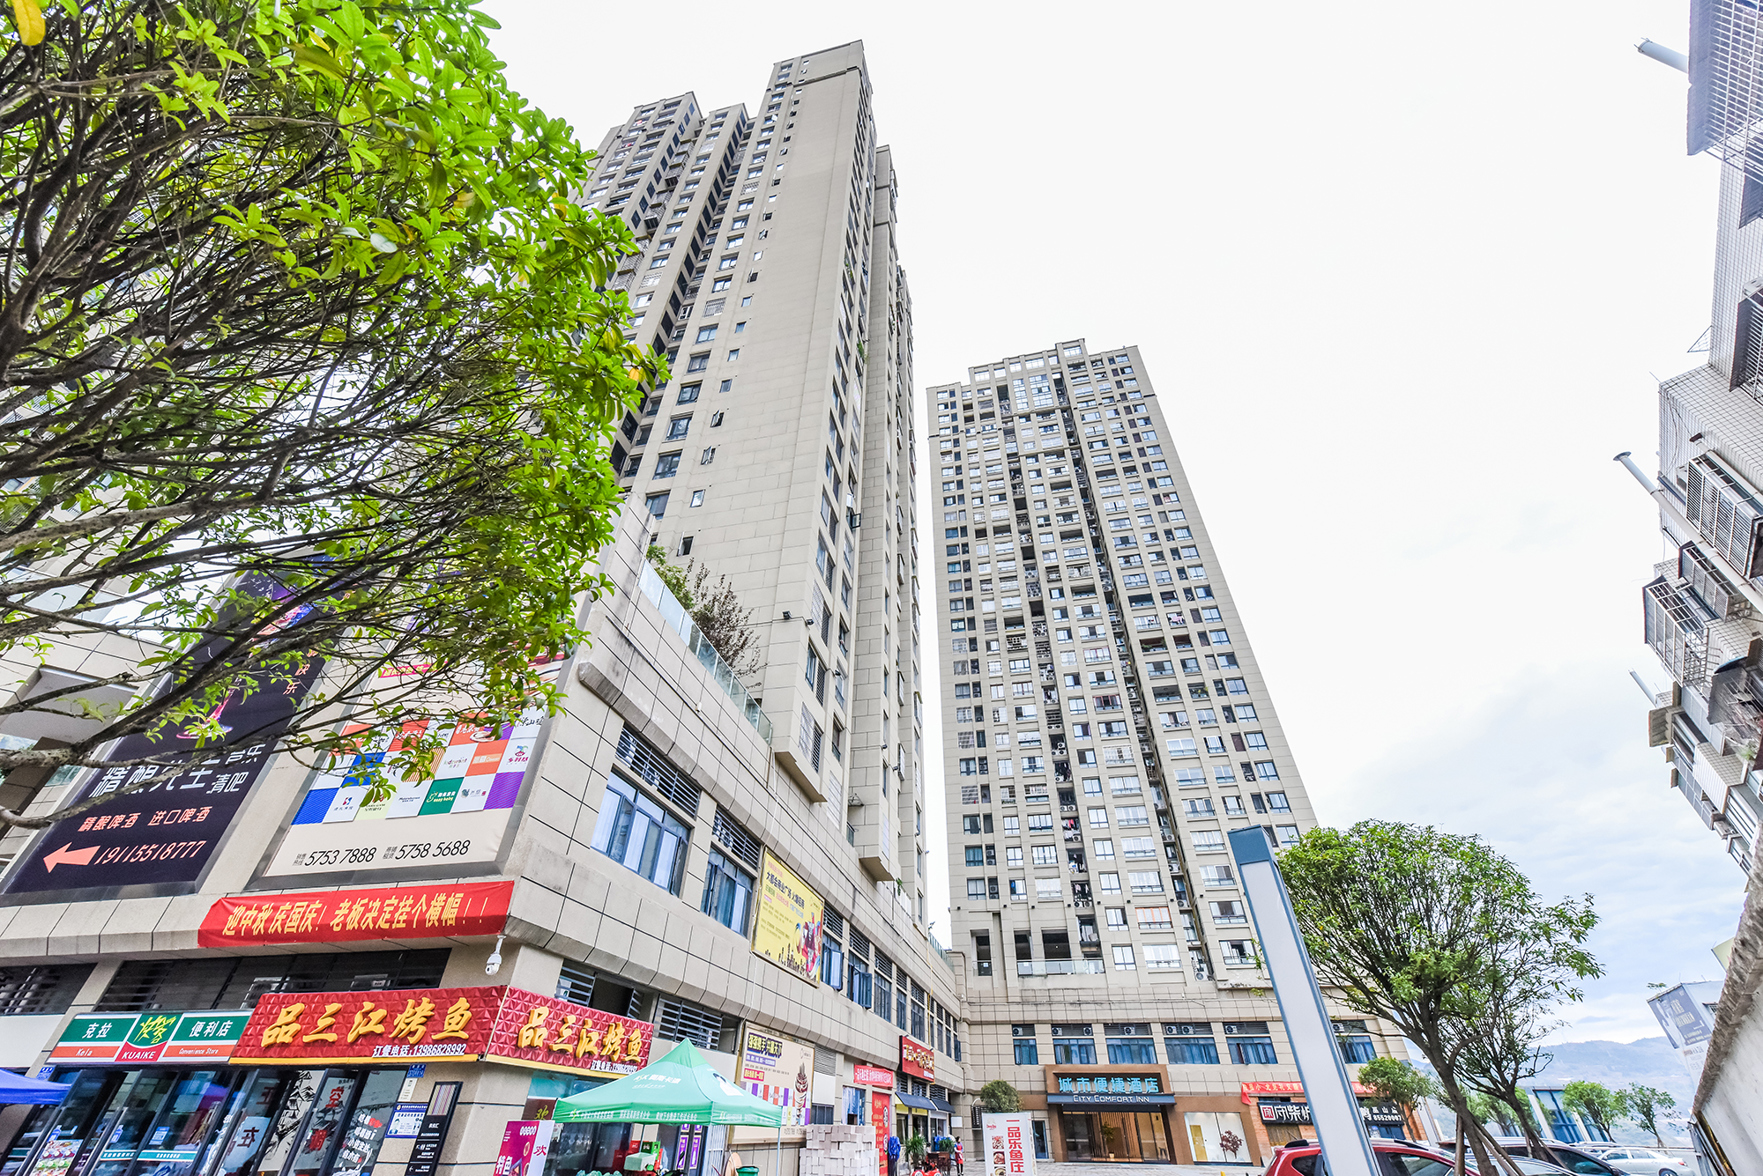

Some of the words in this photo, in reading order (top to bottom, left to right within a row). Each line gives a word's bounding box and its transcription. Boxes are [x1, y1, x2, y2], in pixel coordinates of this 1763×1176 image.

[78, 812, 141, 832] 精酿啤酒
[148, 806, 212, 827] 进口啤酒
[94, 841, 207, 865] 19115518777
[305, 850, 340, 866] 5753
[339, 847, 377, 864] 7888
[395, 842, 431, 860] 5758
[432, 839, 471, 857] 5688
[82, 1022, 112, 1038] 克拉
[188, 1020, 233, 1037] 便利店
[261, 997, 472, 1048] 品三江烤鱼
[517, 1006, 642, 1063] 品三江烤鱼
[121, 1051, 156, 1060] KUAIKE
[1058, 1077, 1160, 1093] 城市便捷酒店
[1094, 1095, 1133, 1103] COMFORT
[1135, 1095, 1150, 1103] INN
[1006, 1119, 1025, 1173] 一品乐鱼庄
